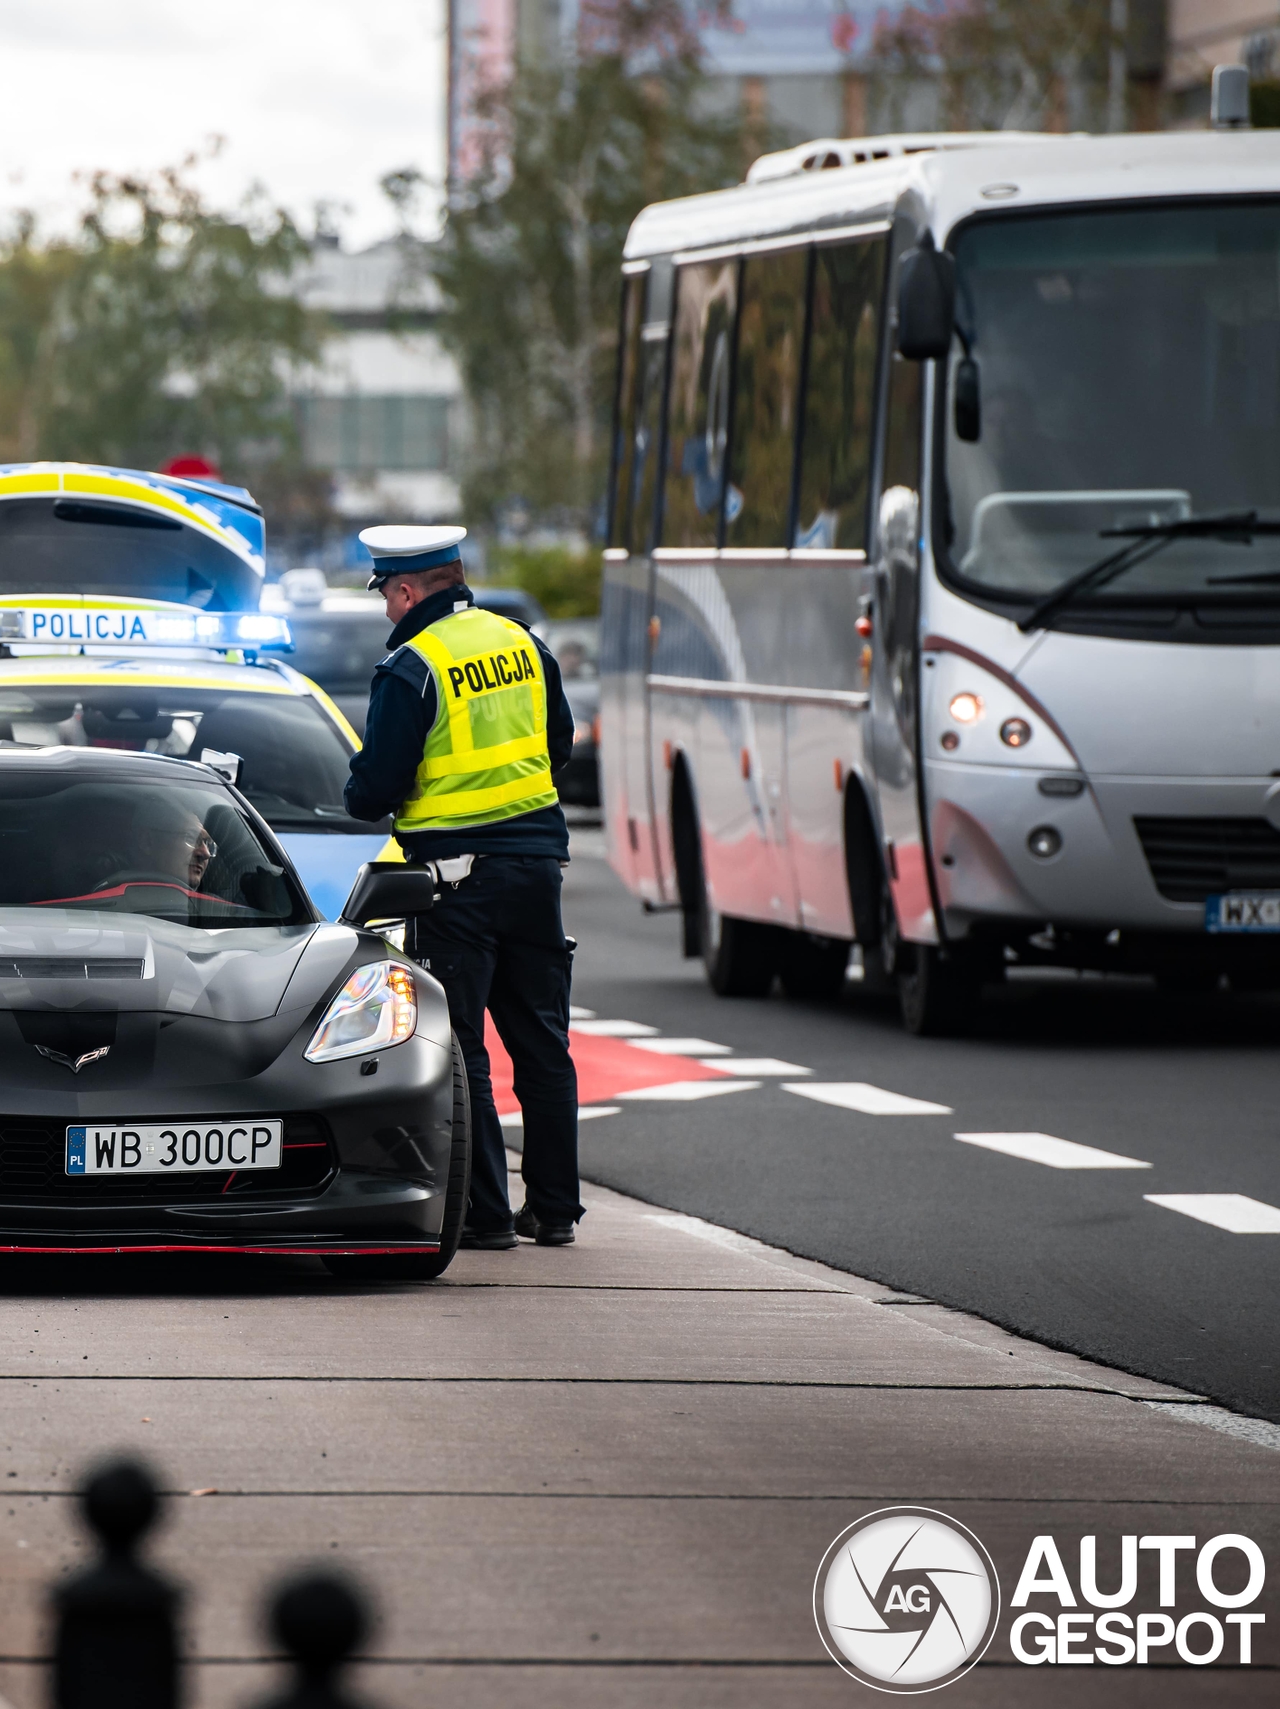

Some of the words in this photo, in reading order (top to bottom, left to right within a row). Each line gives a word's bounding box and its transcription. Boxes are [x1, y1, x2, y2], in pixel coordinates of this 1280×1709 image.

[32, 613, 147, 640] POLICJA
[447, 649, 536, 698] POLICJA
[70, 1155, 84, 1166] PL
[94, 1131, 142, 1169] WB
[158, 1126, 273, 1167] 300CP
